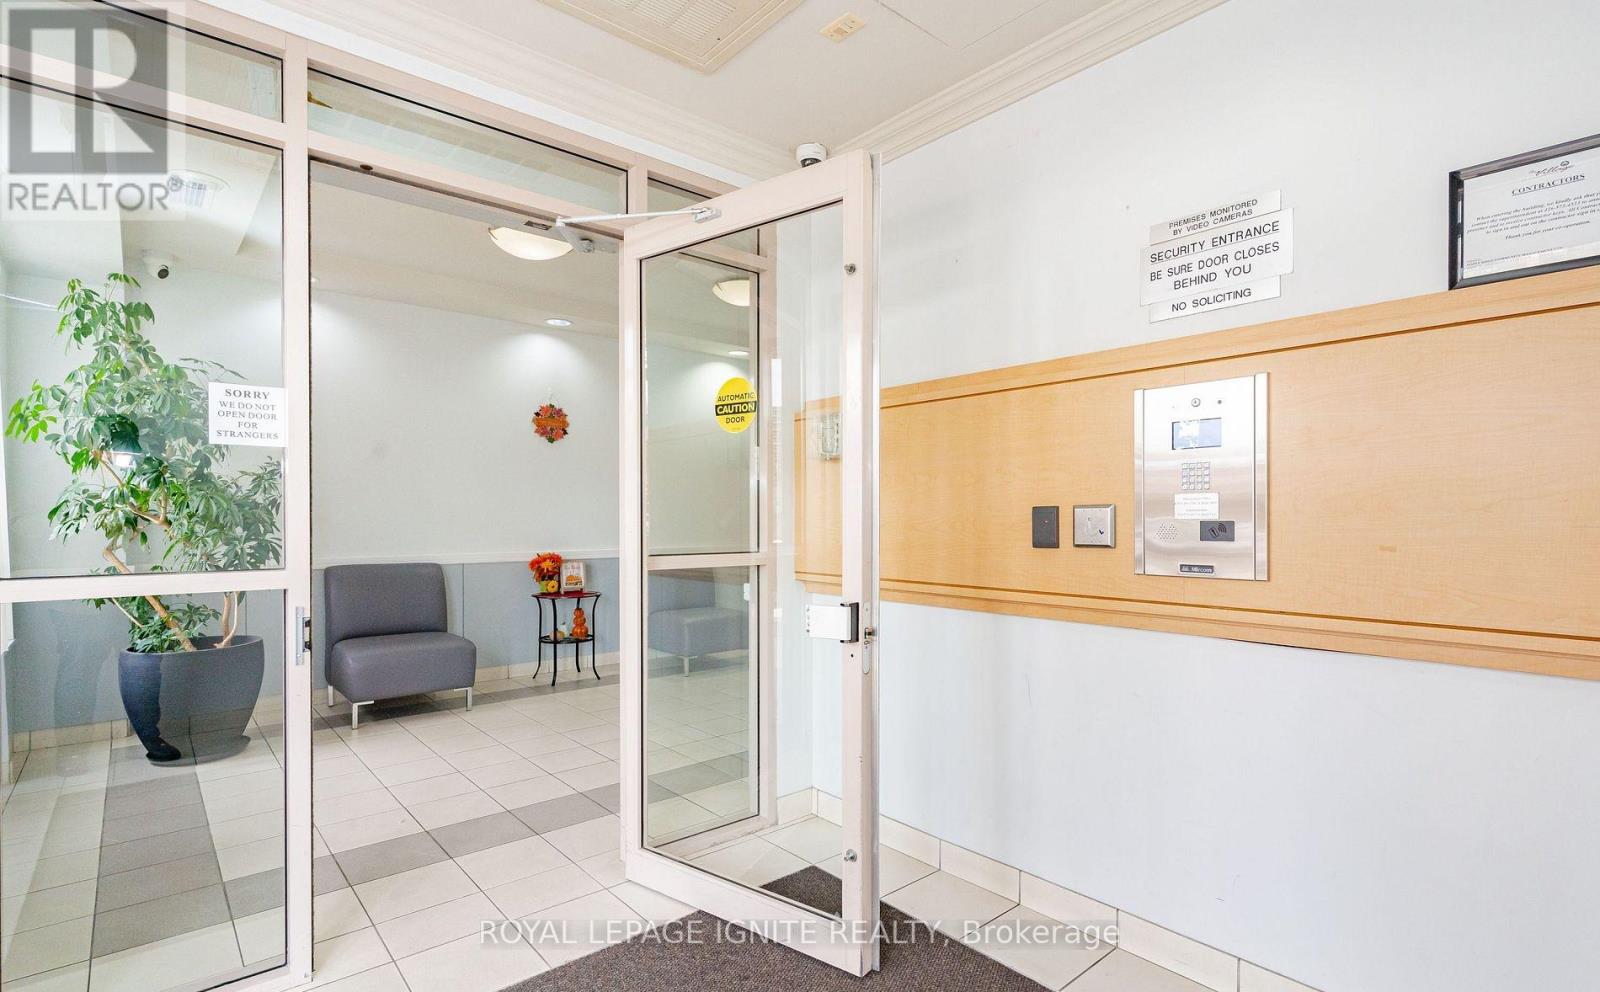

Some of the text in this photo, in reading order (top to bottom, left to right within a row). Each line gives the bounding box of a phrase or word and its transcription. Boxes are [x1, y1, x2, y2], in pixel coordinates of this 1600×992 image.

[1512, 173, 1585, 195] CONTRACTORS
[1168, 199, 1258, 230] PREMISES MONITORED
[1172, 209, 1253, 236] BY VIDEO CAMERAS
[1150, 220, 1280, 263] SECURITY ENTRANCE
[1150, 241, 1280, 282] BE SURE DOOR CLOSES
[1173, 263, 1252, 291] BEHIND YOU
[1171, 288, 1252, 313] NO SOLICITING
[225, 388, 270, 400] SORRY
[718, 393, 755, 402] AUTOMATIC
[219, 400, 235, 409] WE
[238, 402, 253, 410] DO
[717, 403, 755, 414] CAUTION
[217, 410, 278, 420] OPEN DOOR
[726, 416, 745, 424] DOOR
[238, 421, 258, 429] FOR
[216, 429, 279, 440] STRANGERS
